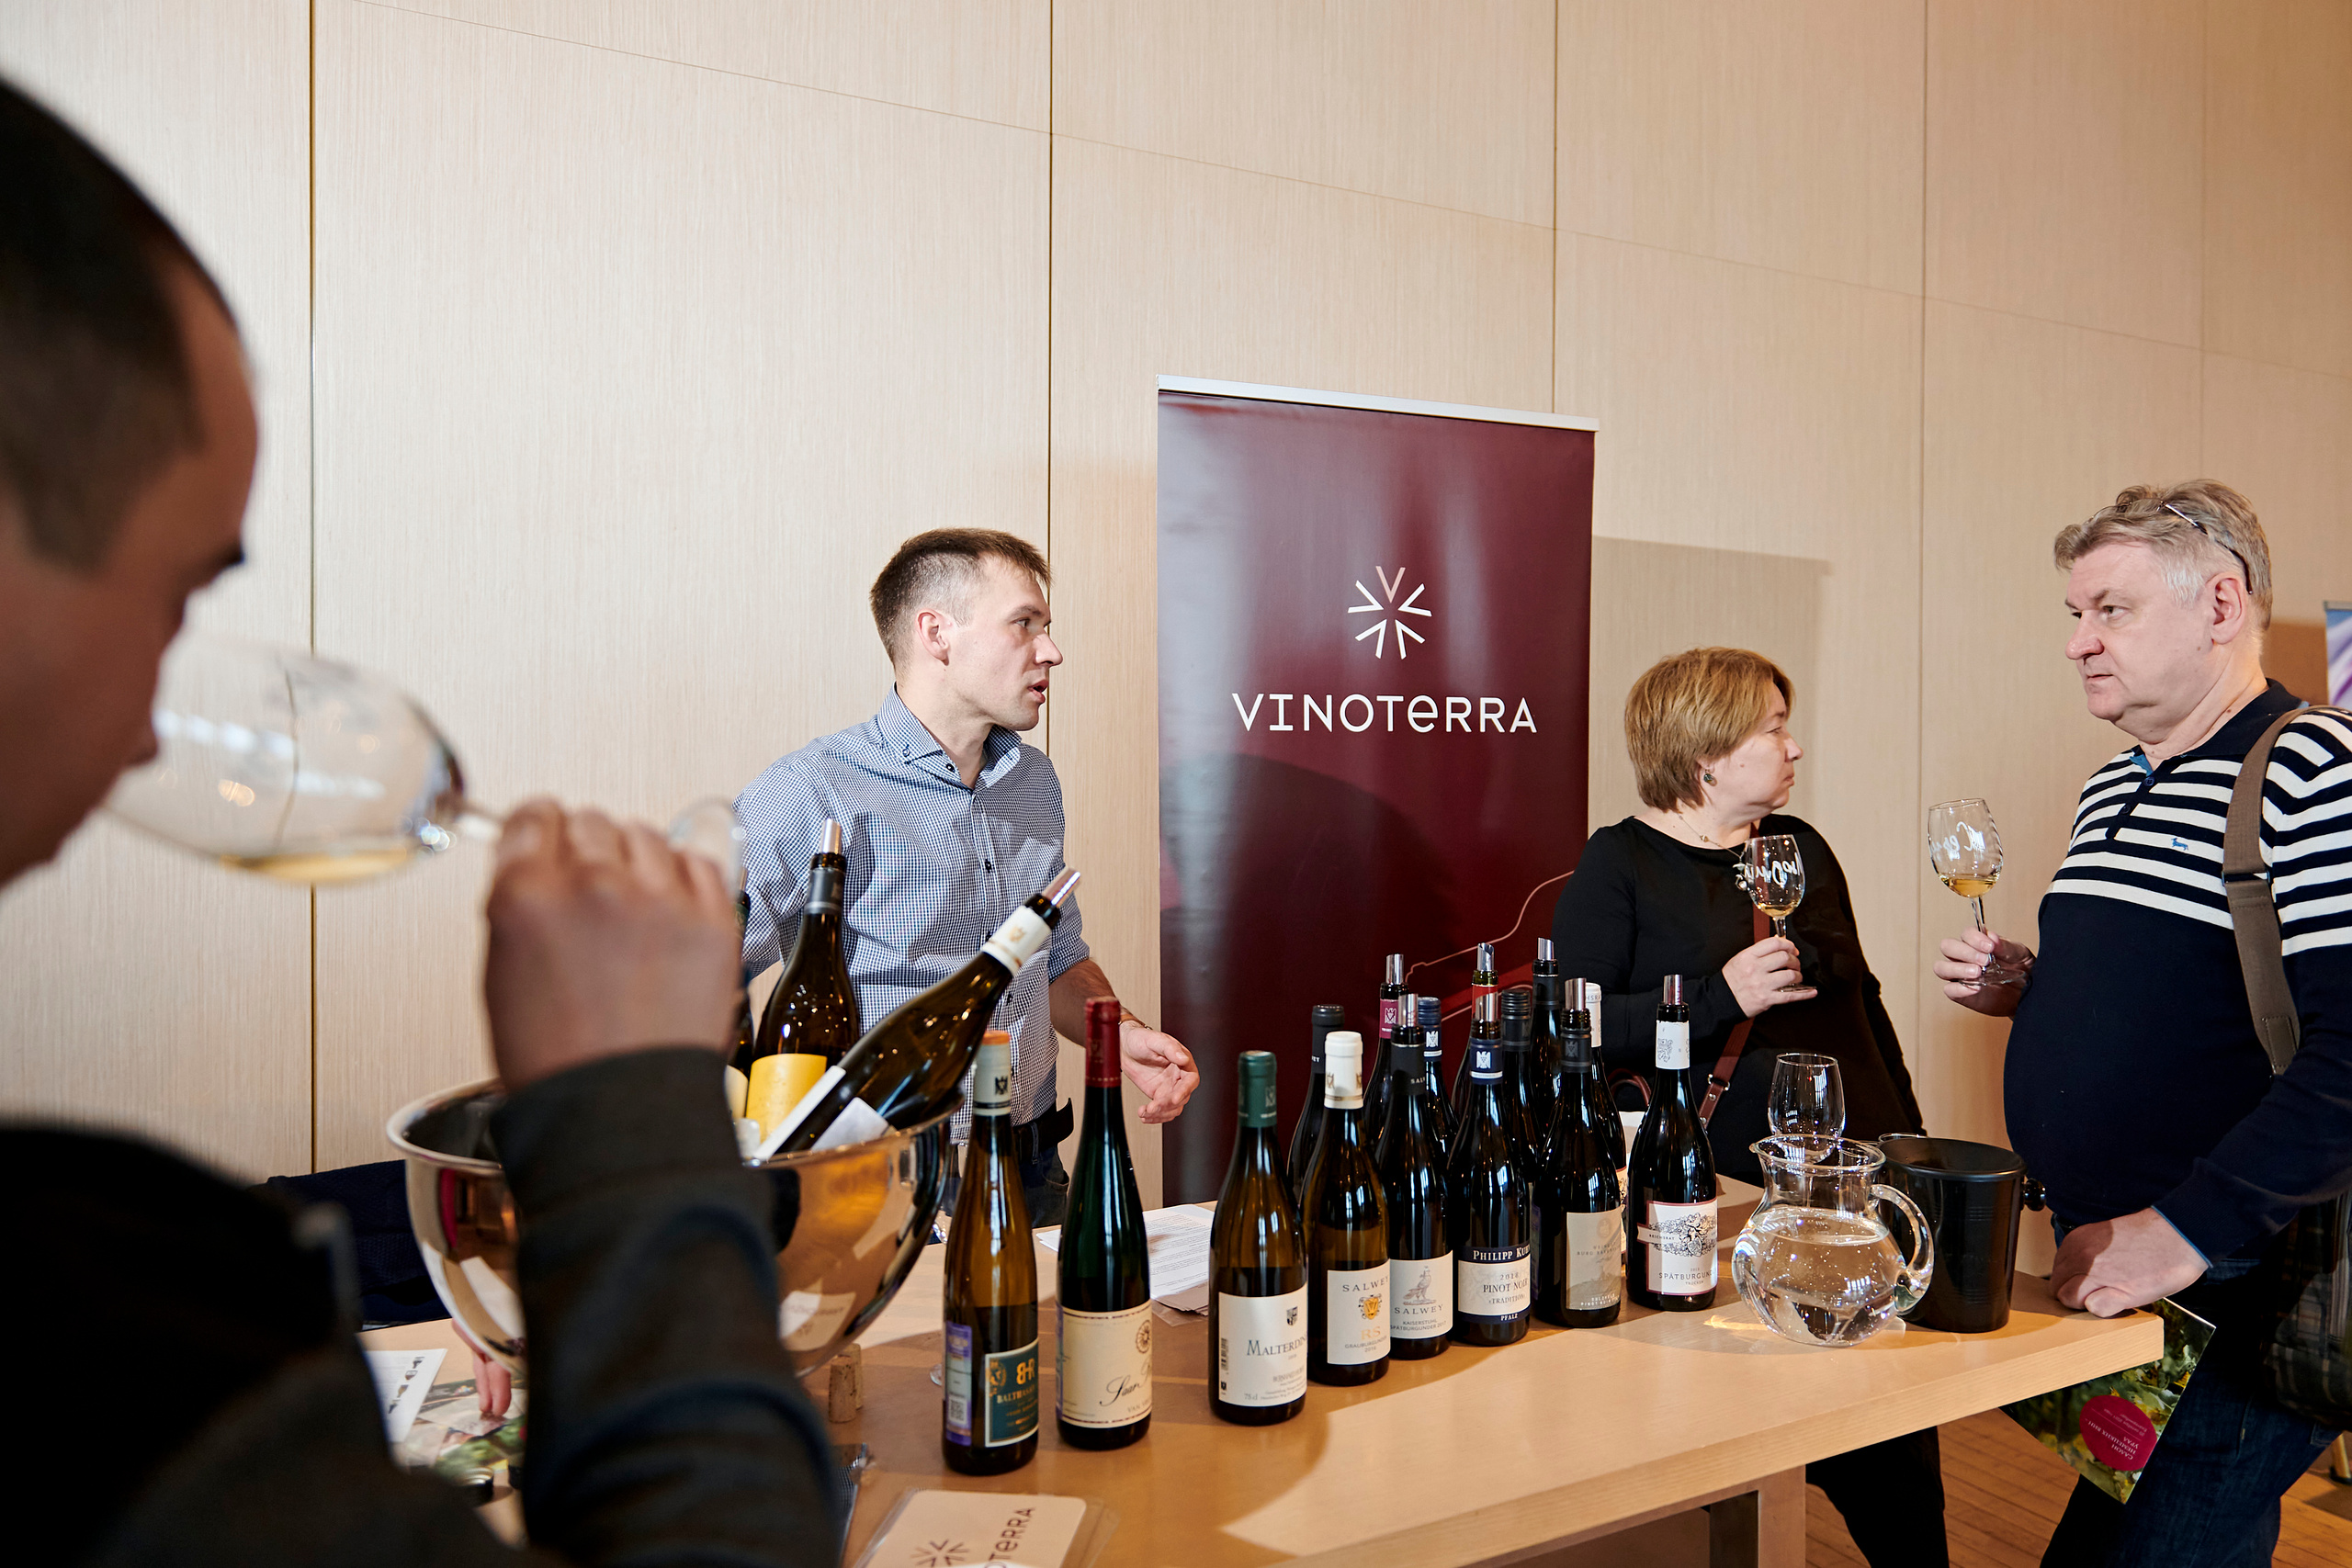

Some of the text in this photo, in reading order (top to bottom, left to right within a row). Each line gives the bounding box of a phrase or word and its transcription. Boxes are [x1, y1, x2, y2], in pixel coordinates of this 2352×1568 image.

[1342, 1276, 1389, 1292] SALWEY
[1483, 1283, 1510, 1293] PINOT
[1394, 1304, 1443, 1314] SALWEY
[1500, 1313, 1519, 1321] PFALZ
[1361, 1325, 1381, 1340] RS
[2087, 1420, 2102, 1432] ВИН
[2101, 1429, 2136, 1454] НЕМЕЦКИХ
[2123, 1437, 2139, 1450] УРАЛ
[2111, 1444, 2133, 1461] САЛОН
[983, 1506, 1035, 1568] TeRRA
